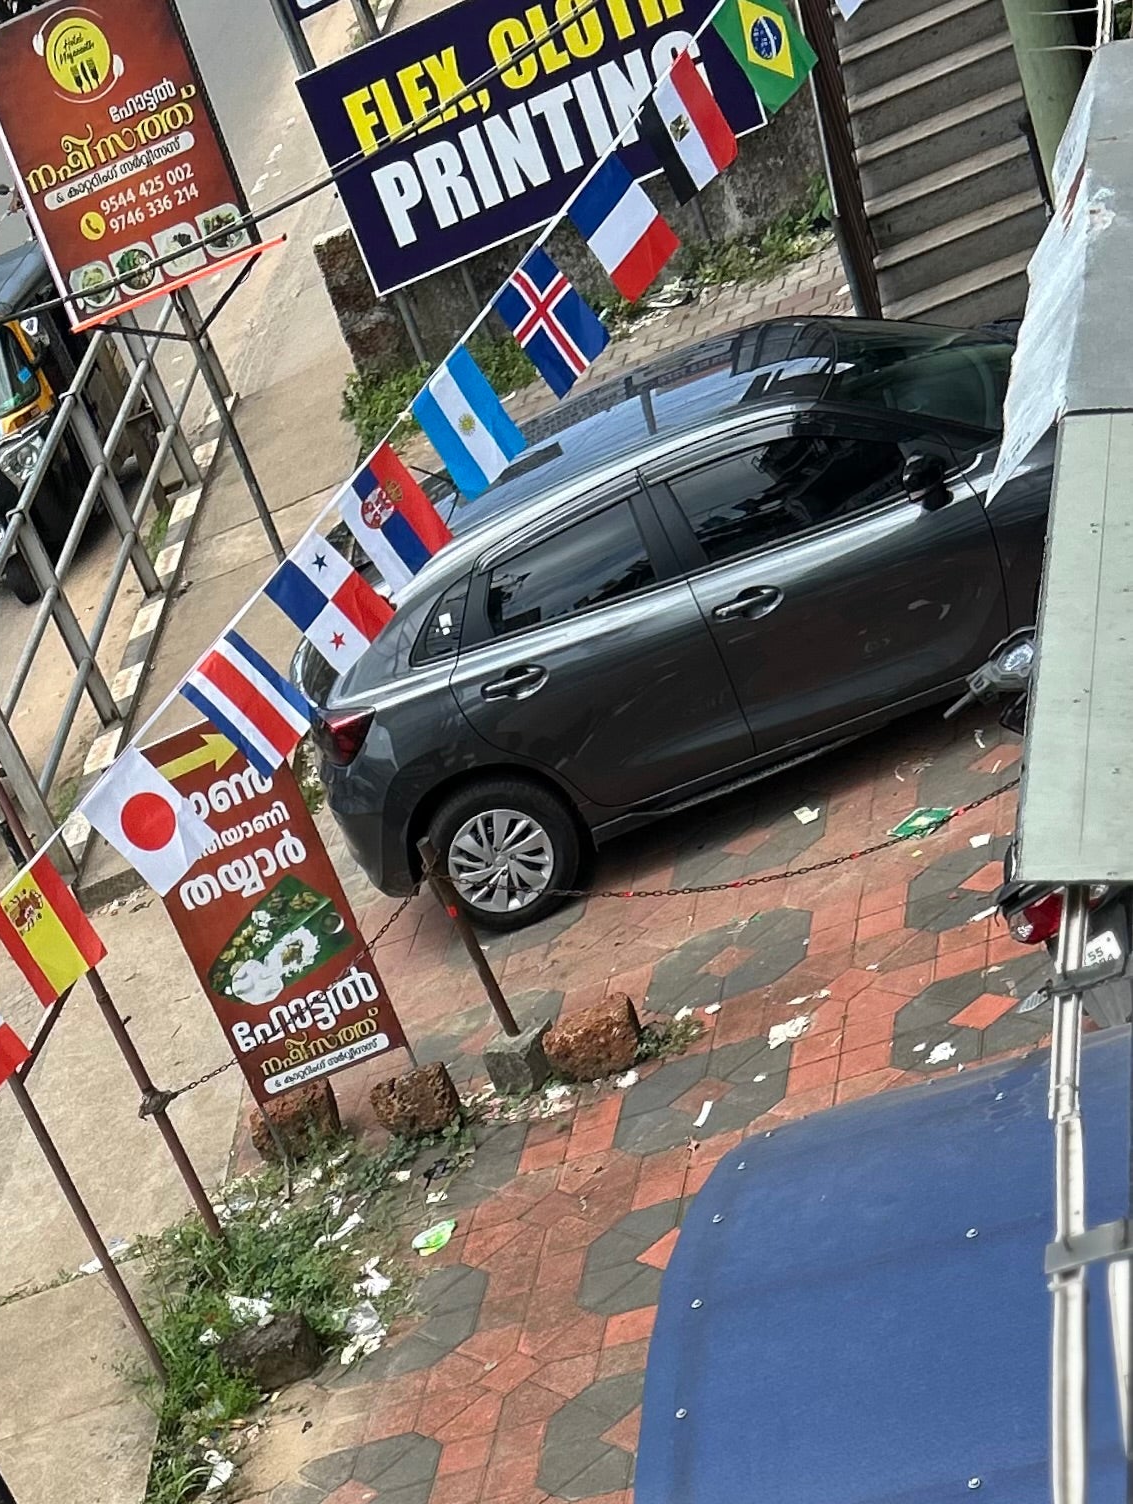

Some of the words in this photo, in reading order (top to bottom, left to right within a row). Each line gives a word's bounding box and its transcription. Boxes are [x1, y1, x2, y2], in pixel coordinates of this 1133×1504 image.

[108, 77, 177, 124] ഹോട്ടൽ
[341, 45, 491, 158] FLEX,
[100, 187, 136, 215] 9544
[138, 175, 165, 198] 425
[166, 163, 194, 184] 002
[109, 207, 145, 234] 9746
[145, 195, 173, 219] 336
[174, 183, 199, 205] 214
[178, 828, 307, 912] തയ്യാർ
[1088, 947, 1104, 961] 55
[231, 965, 379, 1053] ഹോട്ടൽ
